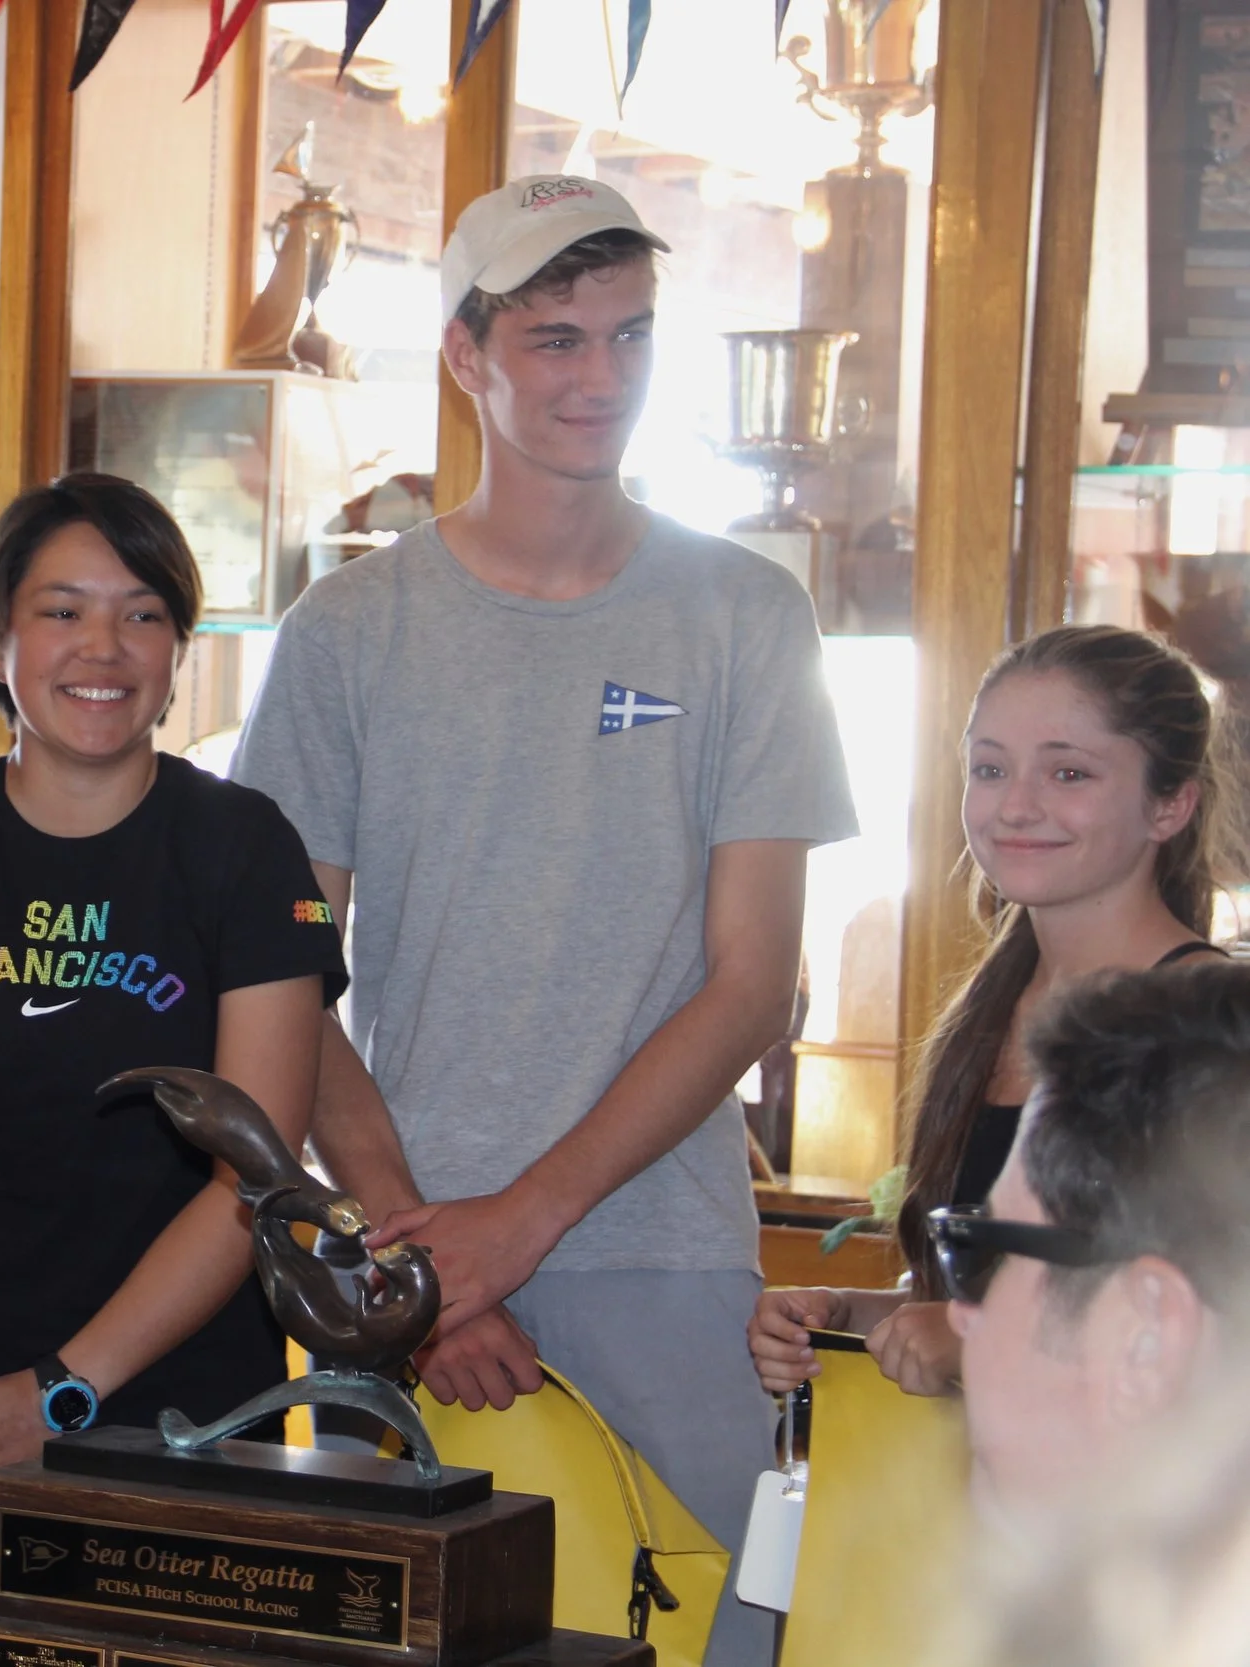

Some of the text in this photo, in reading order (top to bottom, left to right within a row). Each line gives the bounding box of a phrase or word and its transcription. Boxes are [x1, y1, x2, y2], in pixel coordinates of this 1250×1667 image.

[22, 901, 110, 942] SAN
[82, 1538, 316, 1592] Sea Otter Regatta
[96, 1578, 141, 1597] PCISA
